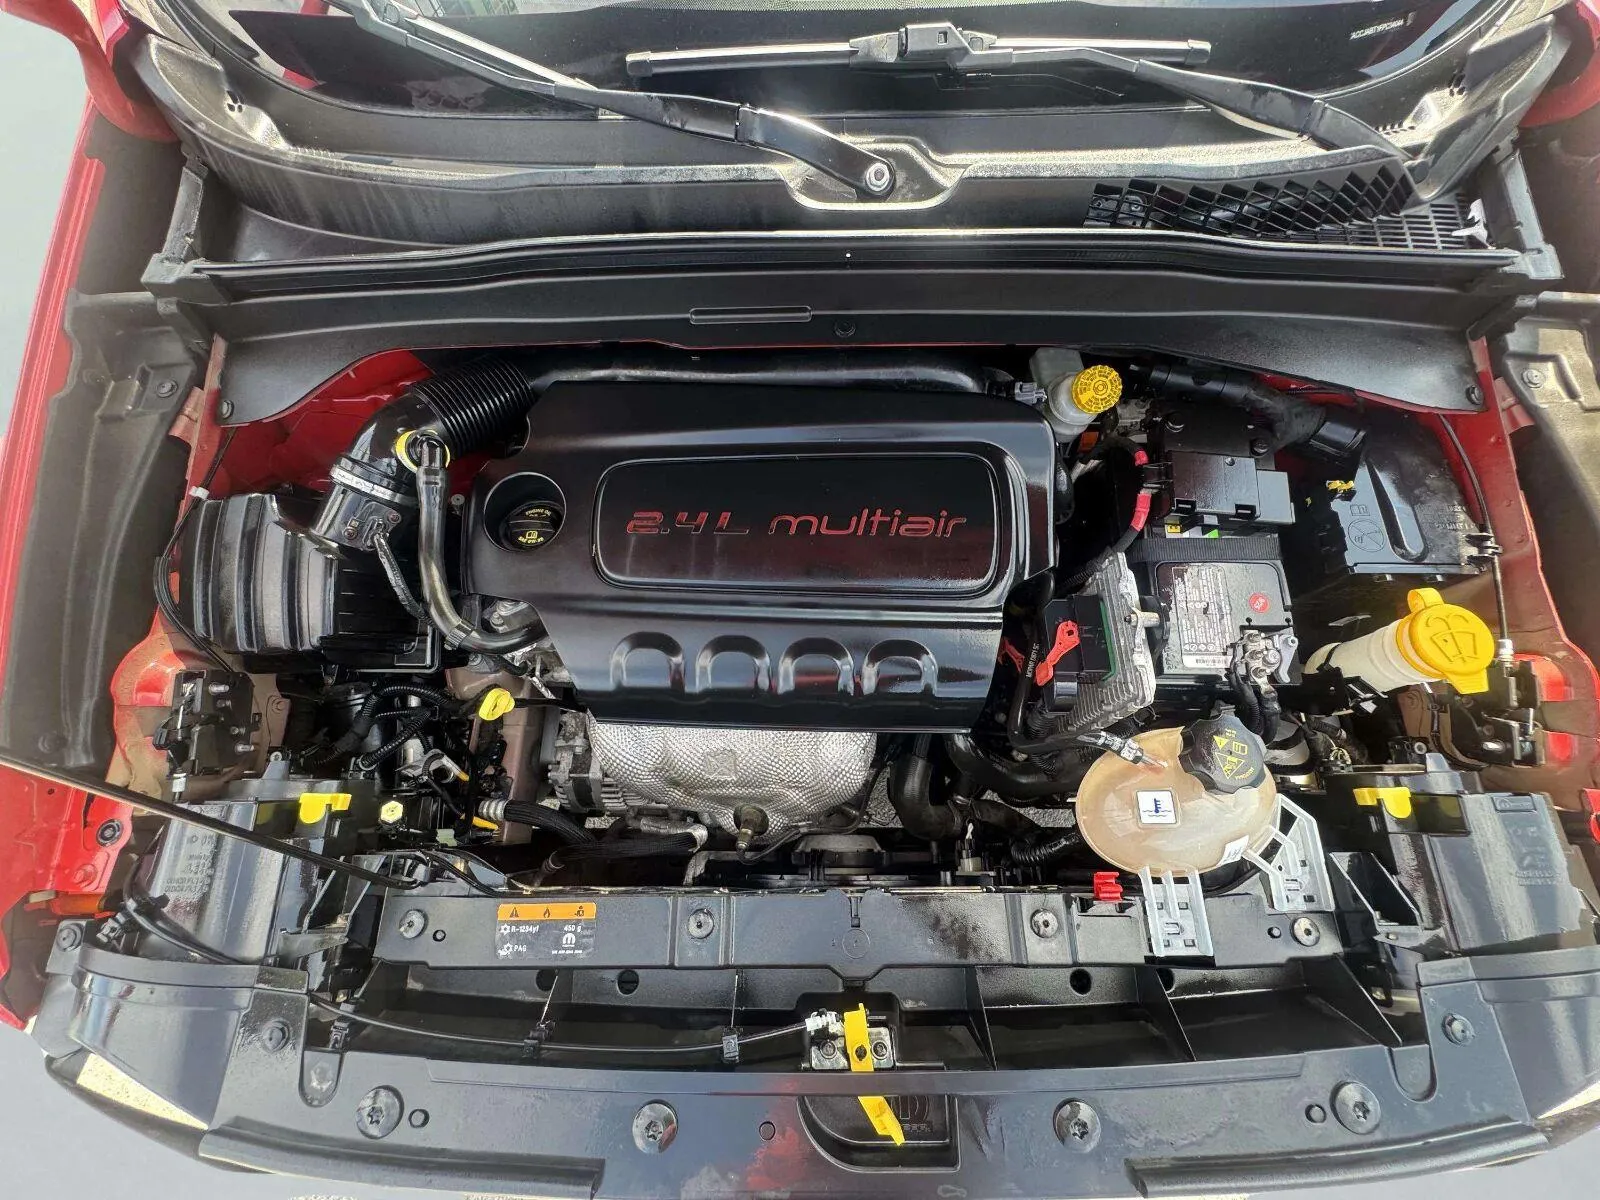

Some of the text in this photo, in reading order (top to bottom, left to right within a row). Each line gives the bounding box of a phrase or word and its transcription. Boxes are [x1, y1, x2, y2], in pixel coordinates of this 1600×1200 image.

[768, 508, 967, 537] multiair
[511, 924, 540, 934] R-1234yf
[564, 924, 576, 932] 450
[513, 944, 527, 952] PAG
